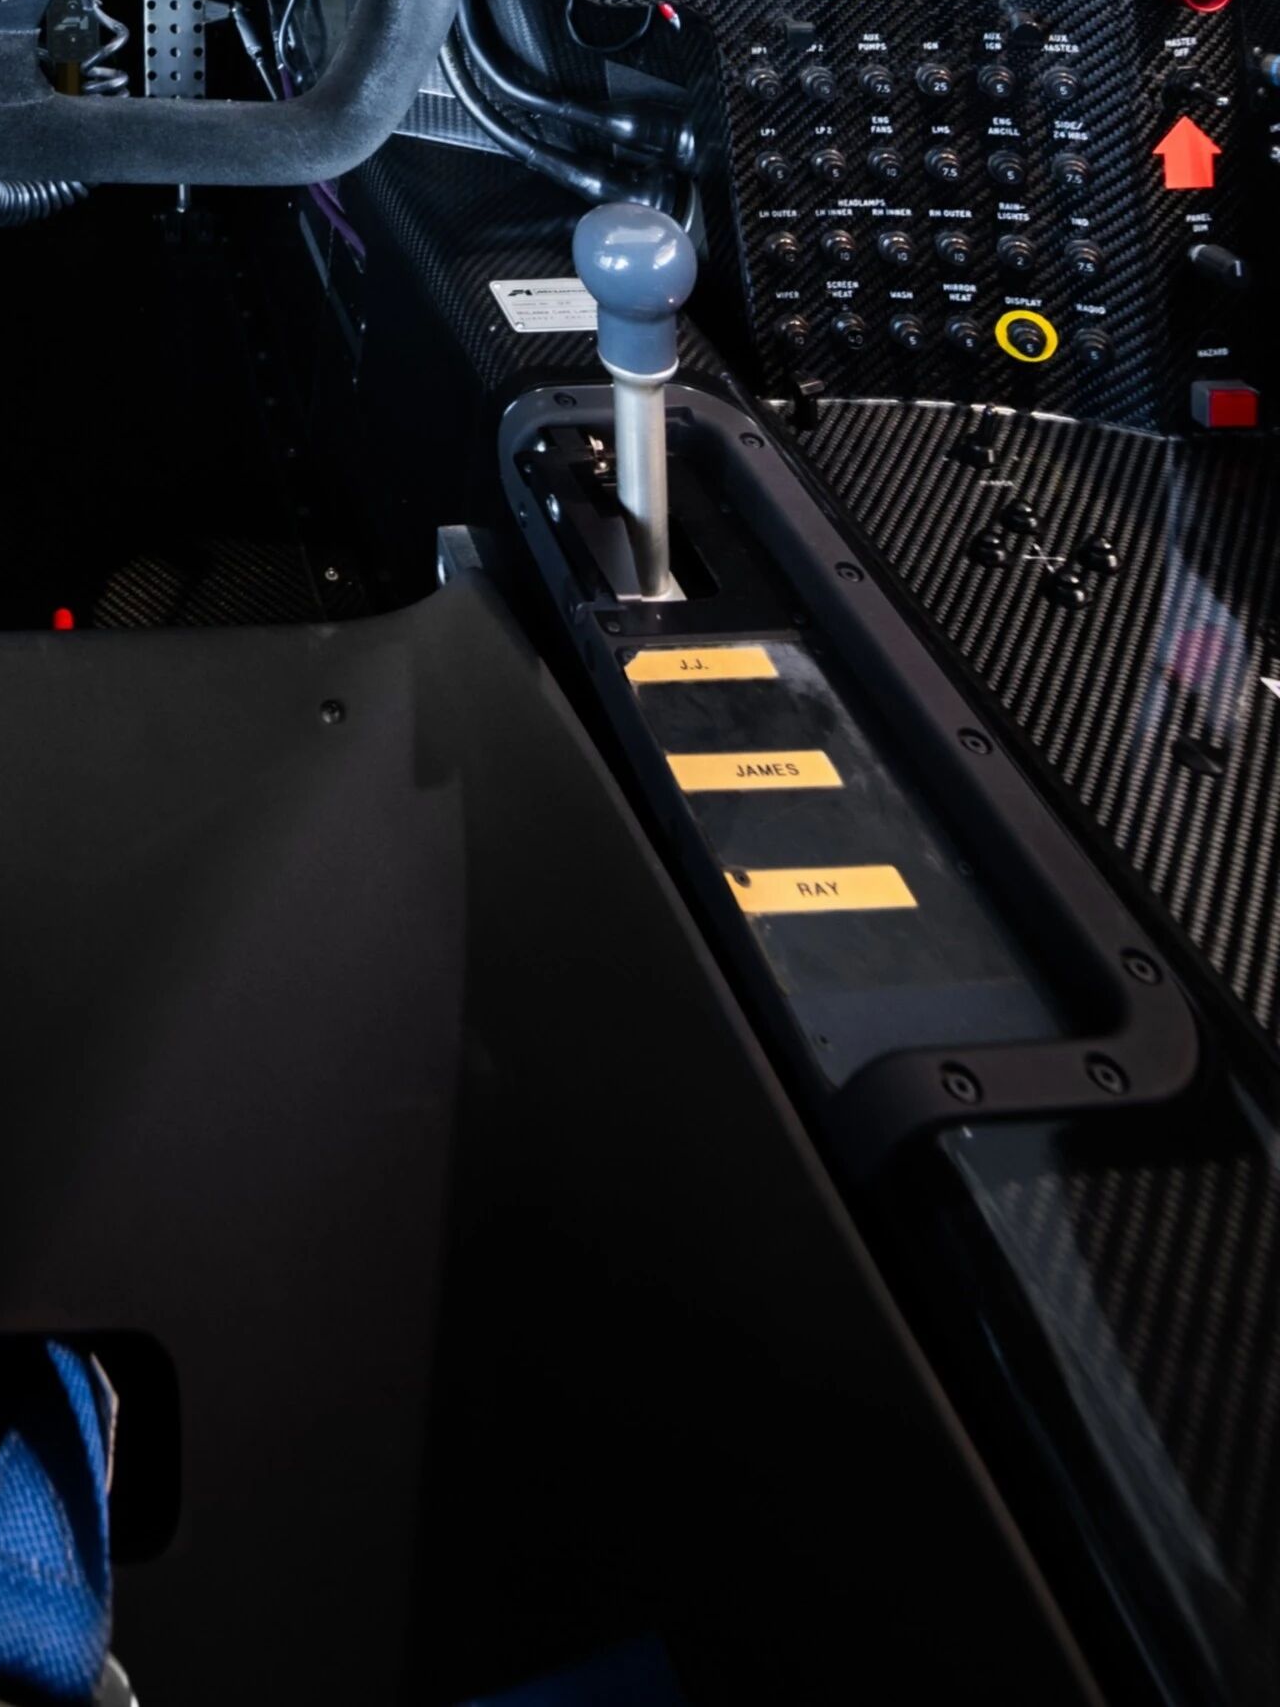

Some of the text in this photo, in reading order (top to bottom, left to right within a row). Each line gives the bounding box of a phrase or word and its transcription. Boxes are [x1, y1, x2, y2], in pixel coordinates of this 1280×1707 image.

[863, 33, 880, 41] AUX
[983, 32, 1002, 41] AUX
[1048, 34, 1068, 43] AUX
[923, 42, 939, 50] IGN
[985, 42, 1002, 50] IGN
[1164, 37, 1197, 47] MASTER
[858, 43, 887, 51] PUMPS
[876, 84, 891, 93] 7.5
[934, 82, 948, 91] 25
[996, 84, 1005, 93] 5
[1059, 86, 1068, 95] 5
[872, 116, 890, 124] ENG
[993, 117, 1012, 125] ENG
[870, 125, 893, 134] FANS
[1054, 120, 1084, 130] SIDE/
[988, 127, 1020, 136] ANCILL
[1053, 131, 1088, 141] 24 HRS
[776, 170, 784, 179] 5
[832, 168, 840, 177] 5
[886, 167, 897, 177] 10
[942, 167, 958, 177] 7.5
[1007, 171, 1015, 180] 5
[1066, 174, 1082, 184] 7.5
[837, 199, 886, 207] HEADLAMPS
[759, 210, 770, 218] LH
[815, 209, 826, 217] LH
[929, 209, 972, 218] RH OUTER
[997, 212, 1030, 221] LIGHTS
[1186, 213, 1212, 223] PANEL
[840, 252, 850, 261] 10
[897, 252, 908, 261] 10
[954, 252, 965, 262] 10
[1017, 256, 1024, 266] 2
[1077, 262, 1094, 272] 7.5
[826, 281, 859, 289] SCREEN
[943, 283, 977, 292] MIRROR
[776, 291, 800, 299] WIPER
[832, 290, 853, 298] HEAT
[889, 291, 913, 299] WASH
[949, 293, 972, 302] HEAT
[1004, 296, 1042, 307] DISPLAY
[1076, 303, 1106, 315] RADIO
[909, 336, 917, 345] 5
[966, 338, 973, 347] 5
[1026, 344, 1033, 353] 5
[1197, 347, 1228, 358] HAZARD
[1090, 350, 1099, 360] 5
[679, 657, 709, 671] J.J.
[736, 762, 800, 779] JAMES
[796, 881, 840, 897] RAY
